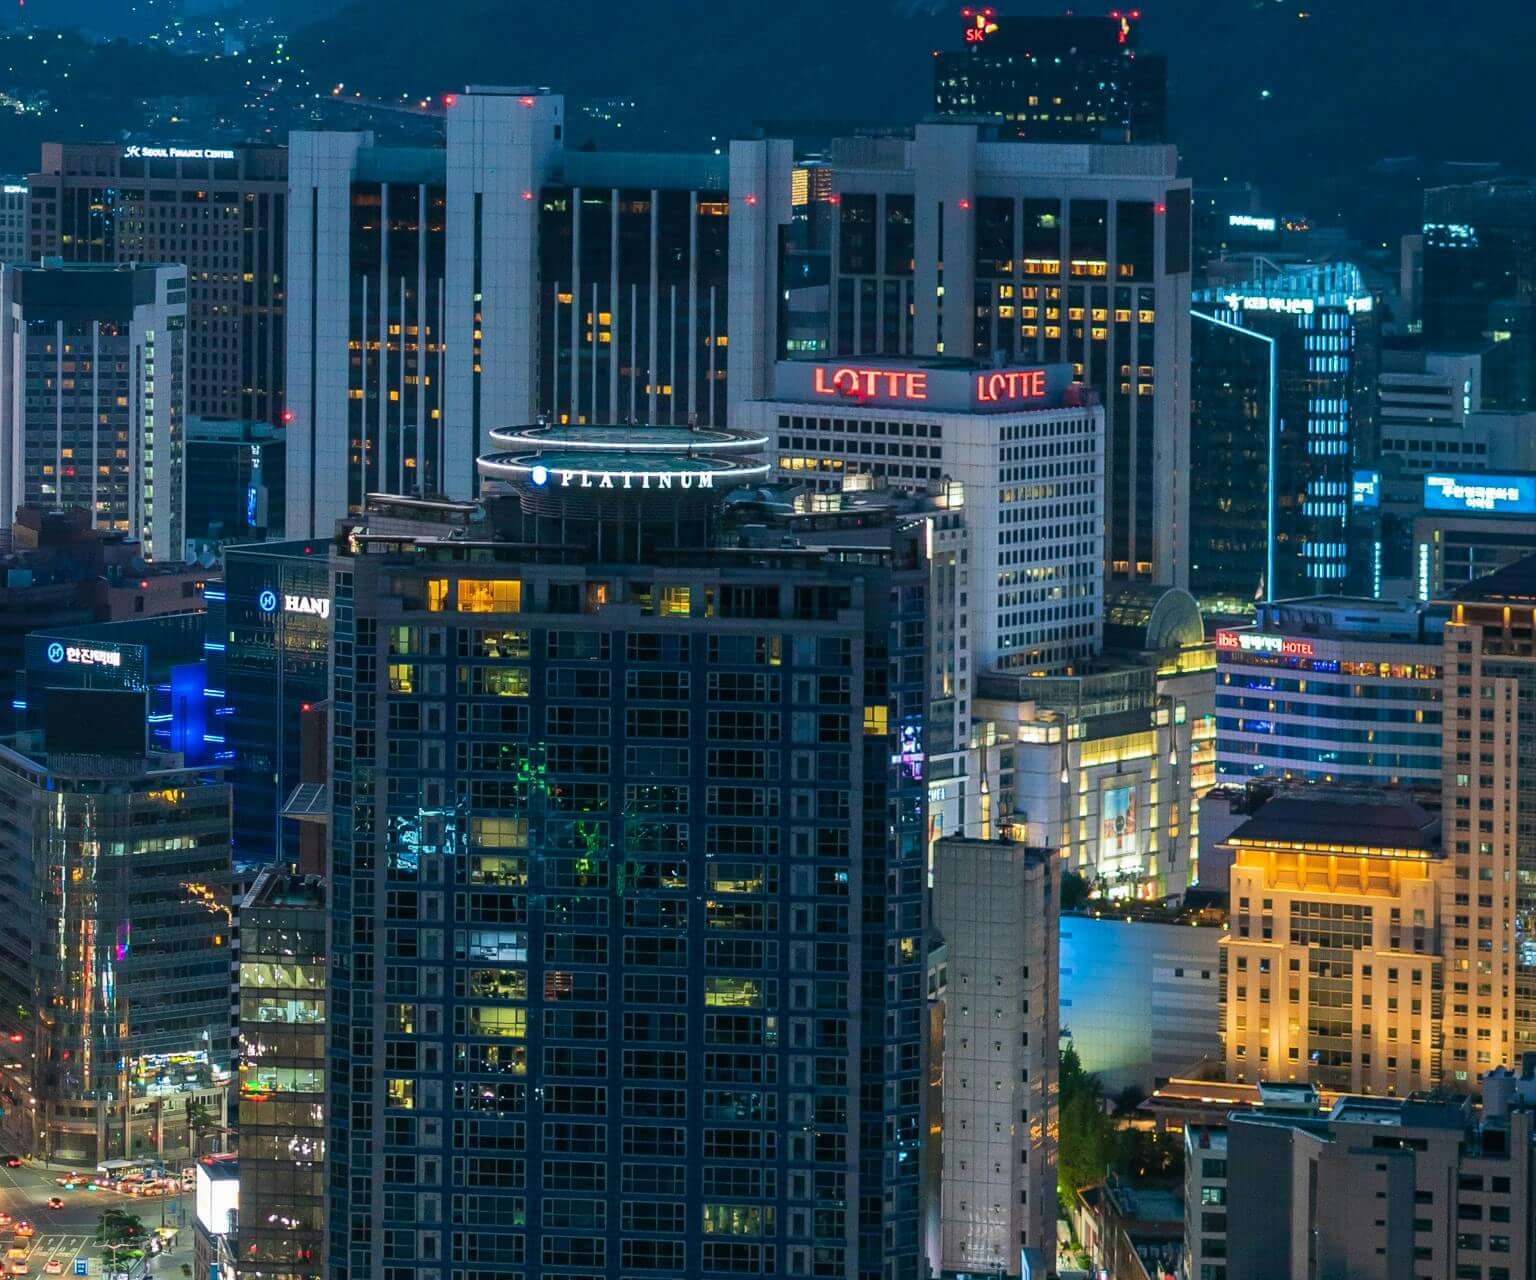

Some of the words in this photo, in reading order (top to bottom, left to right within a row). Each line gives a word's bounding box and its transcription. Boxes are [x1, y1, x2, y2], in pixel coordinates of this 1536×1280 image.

[965, 28, 984, 41] SK
[815, 368, 927, 400] LOTTE
[978, 371, 1045, 400] LOTTE
[560, 471, 714, 488] PLATINUM
[1218, 633, 1238, 647] ibis
[1283, 642, 1313, 654] HOTEL
